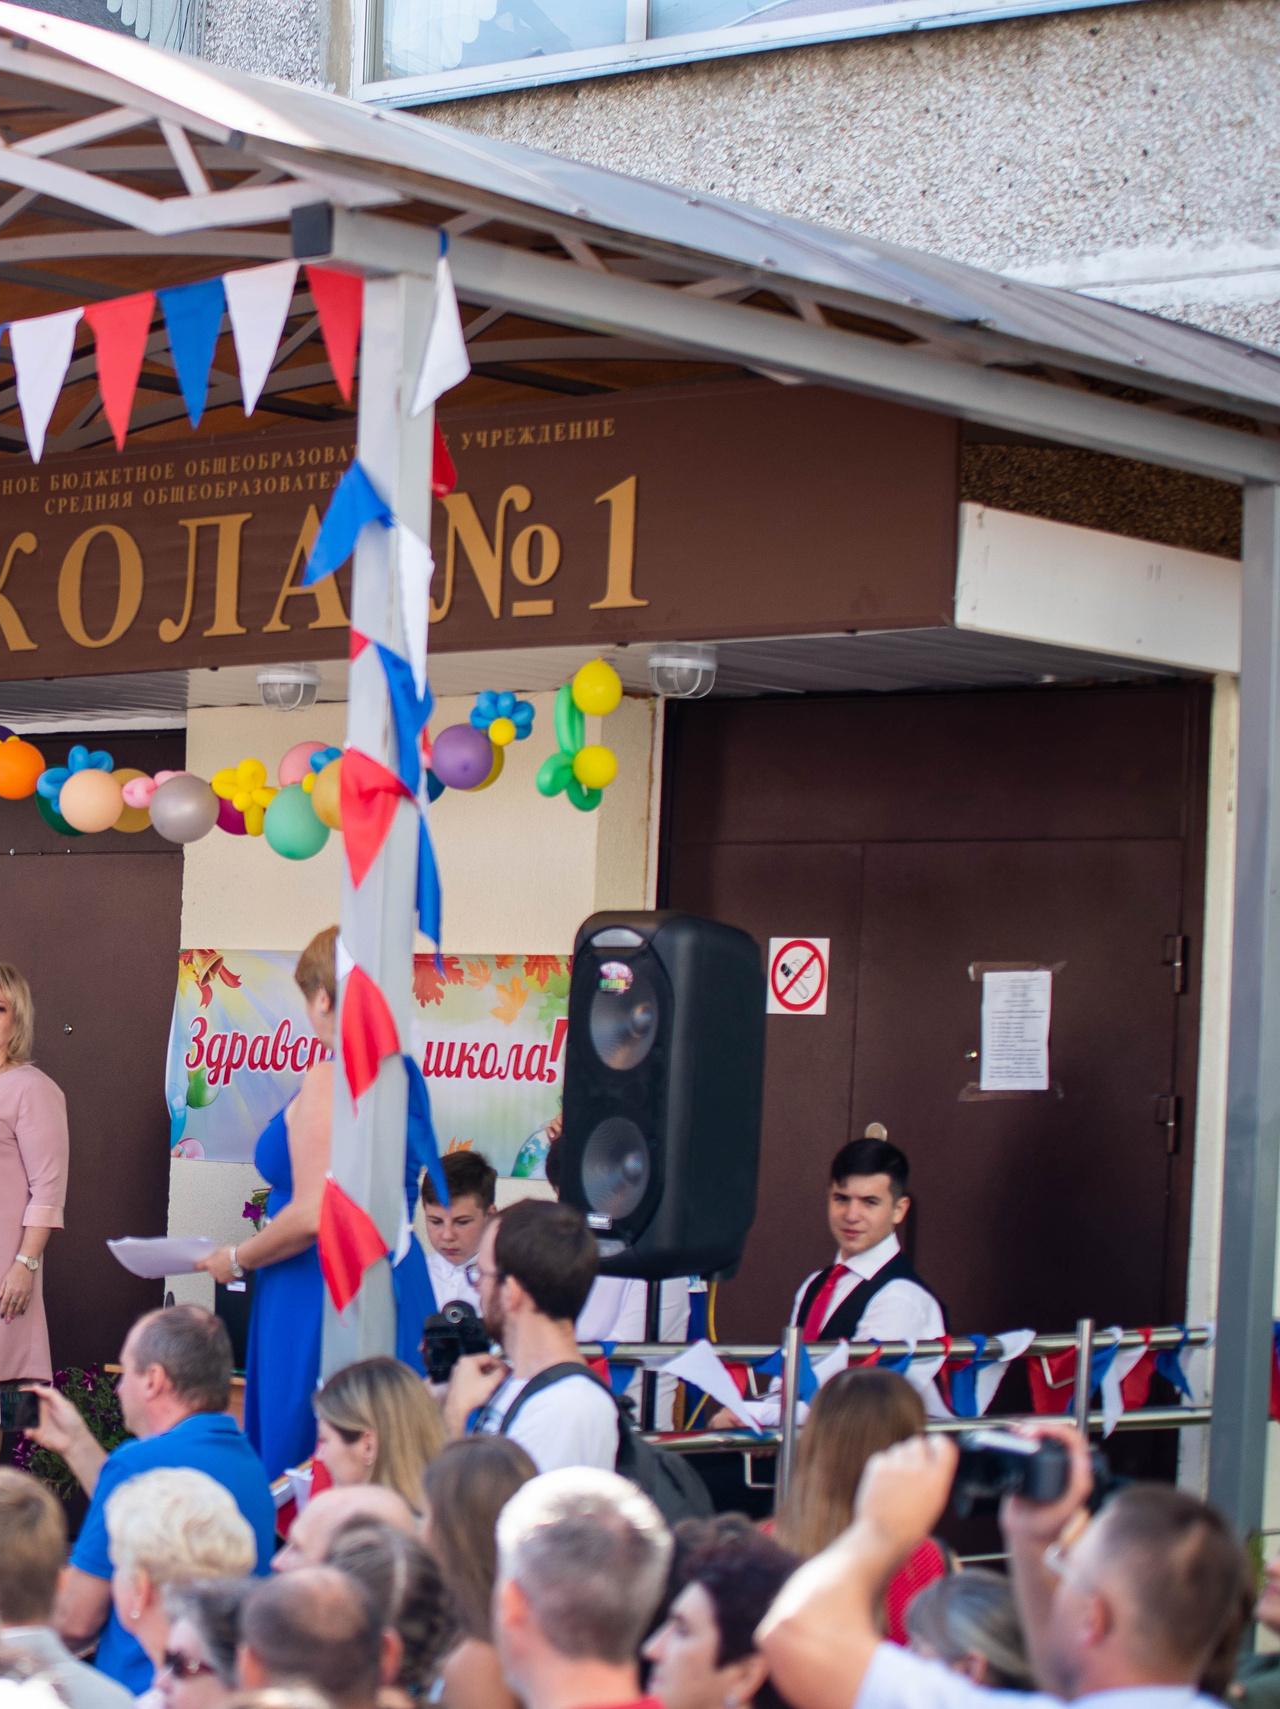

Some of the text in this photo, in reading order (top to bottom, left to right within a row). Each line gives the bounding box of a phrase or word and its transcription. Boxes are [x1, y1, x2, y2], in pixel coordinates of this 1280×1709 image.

[49, 462, 175, 491] БЮДЖЕТНОЕ
[461, 418, 615, 450] УЧРЕЖДЕНИЕ
[44, 470, 344, 515] СРЕДНЯЯ ОБЩЕОБРАЗОВАТЕЛ
[185, 1016, 569, 1086] Здравст школа!
